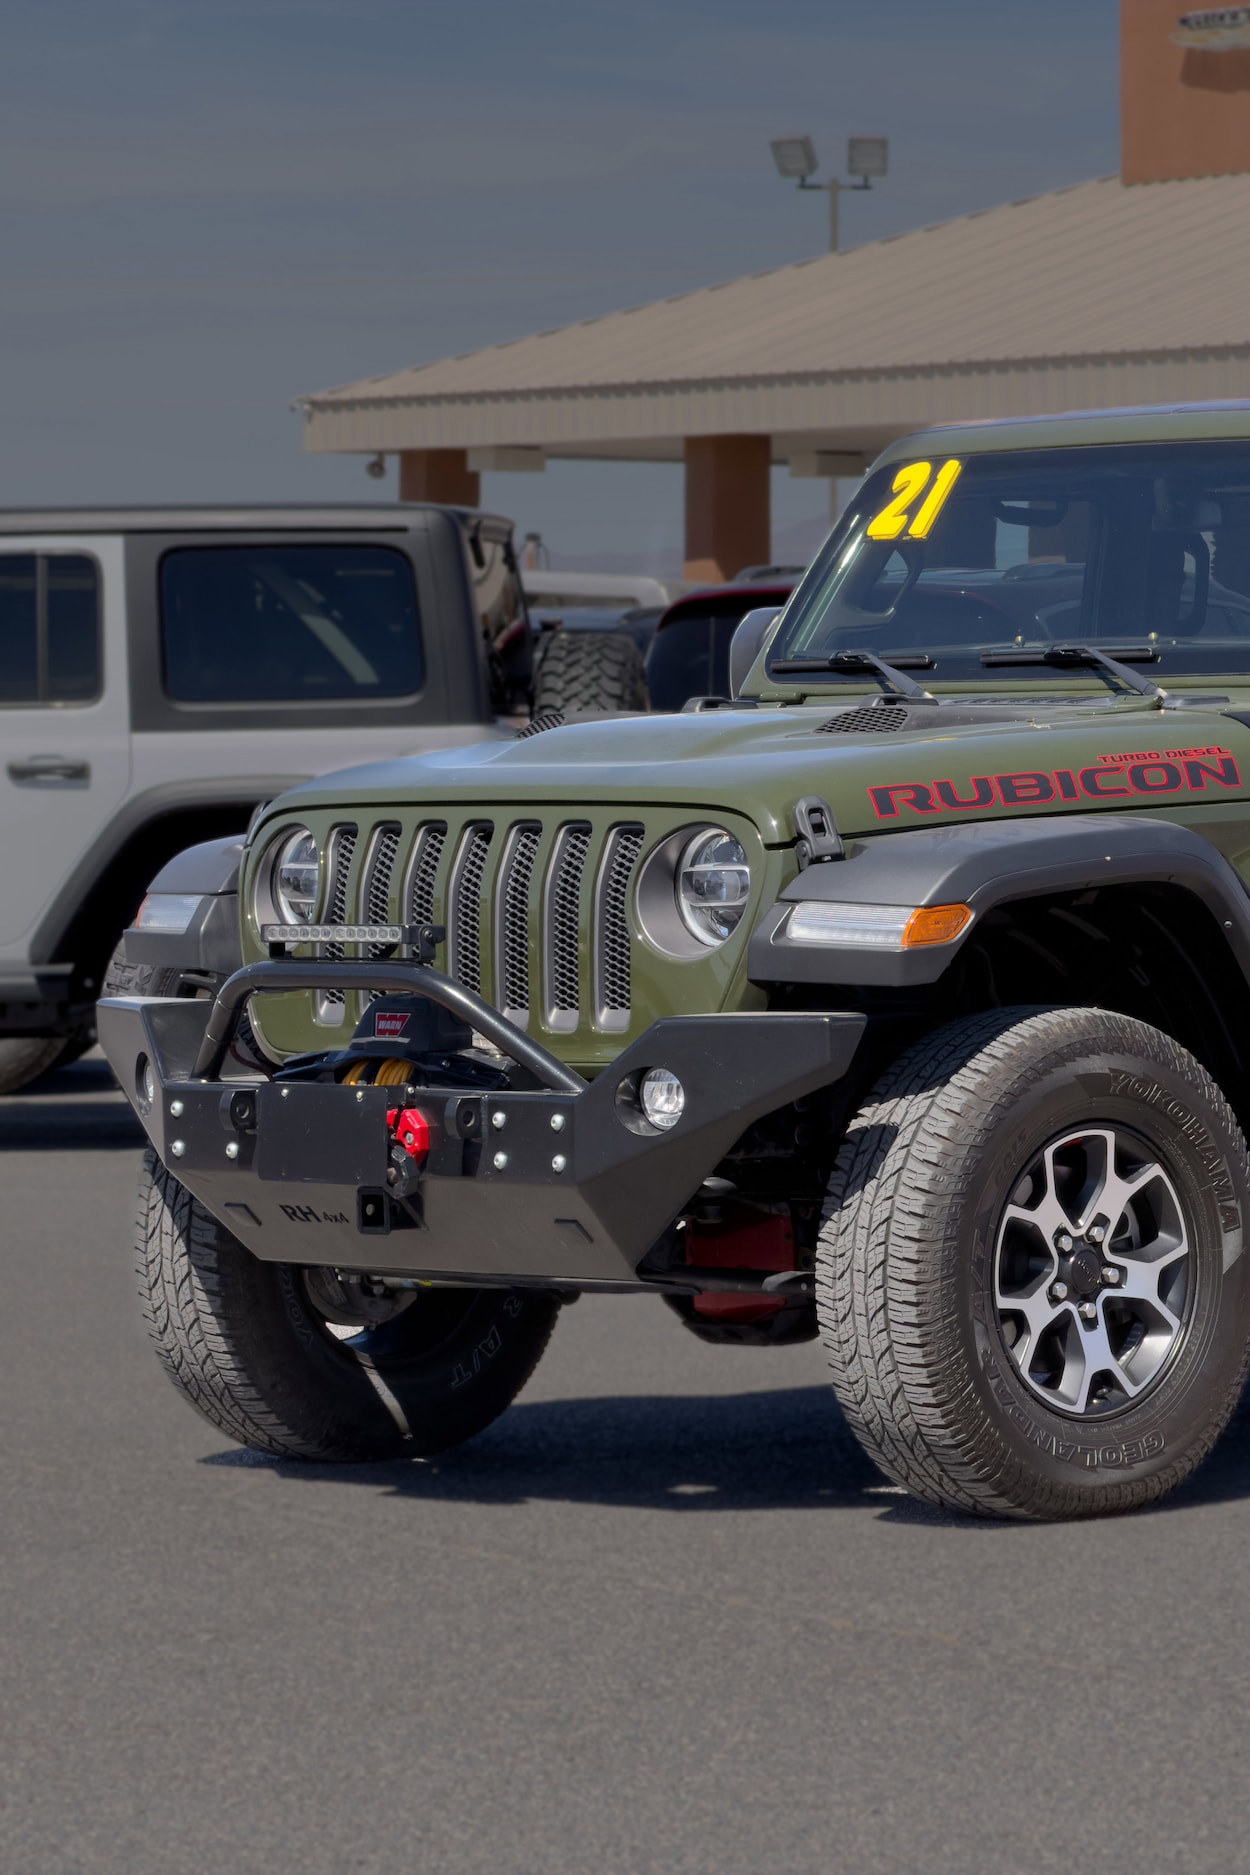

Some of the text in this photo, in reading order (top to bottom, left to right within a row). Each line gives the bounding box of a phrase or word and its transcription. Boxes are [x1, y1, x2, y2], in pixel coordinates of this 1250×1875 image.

[867, 459, 962, 540] 21
[867, 755, 1243, 818] RUBICON
[1097, 745, 1232, 764] TURBO DIESEL
[378, 1020, 403, 1030] WARN
[1107, 1068, 1242, 1233] YOKOHAMA
[278, 1204, 350, 1224] RH 4x4
[450, 1324, 503, 1390] A/T
[980, 1347, 1165, 1467] GEOLANDAR
